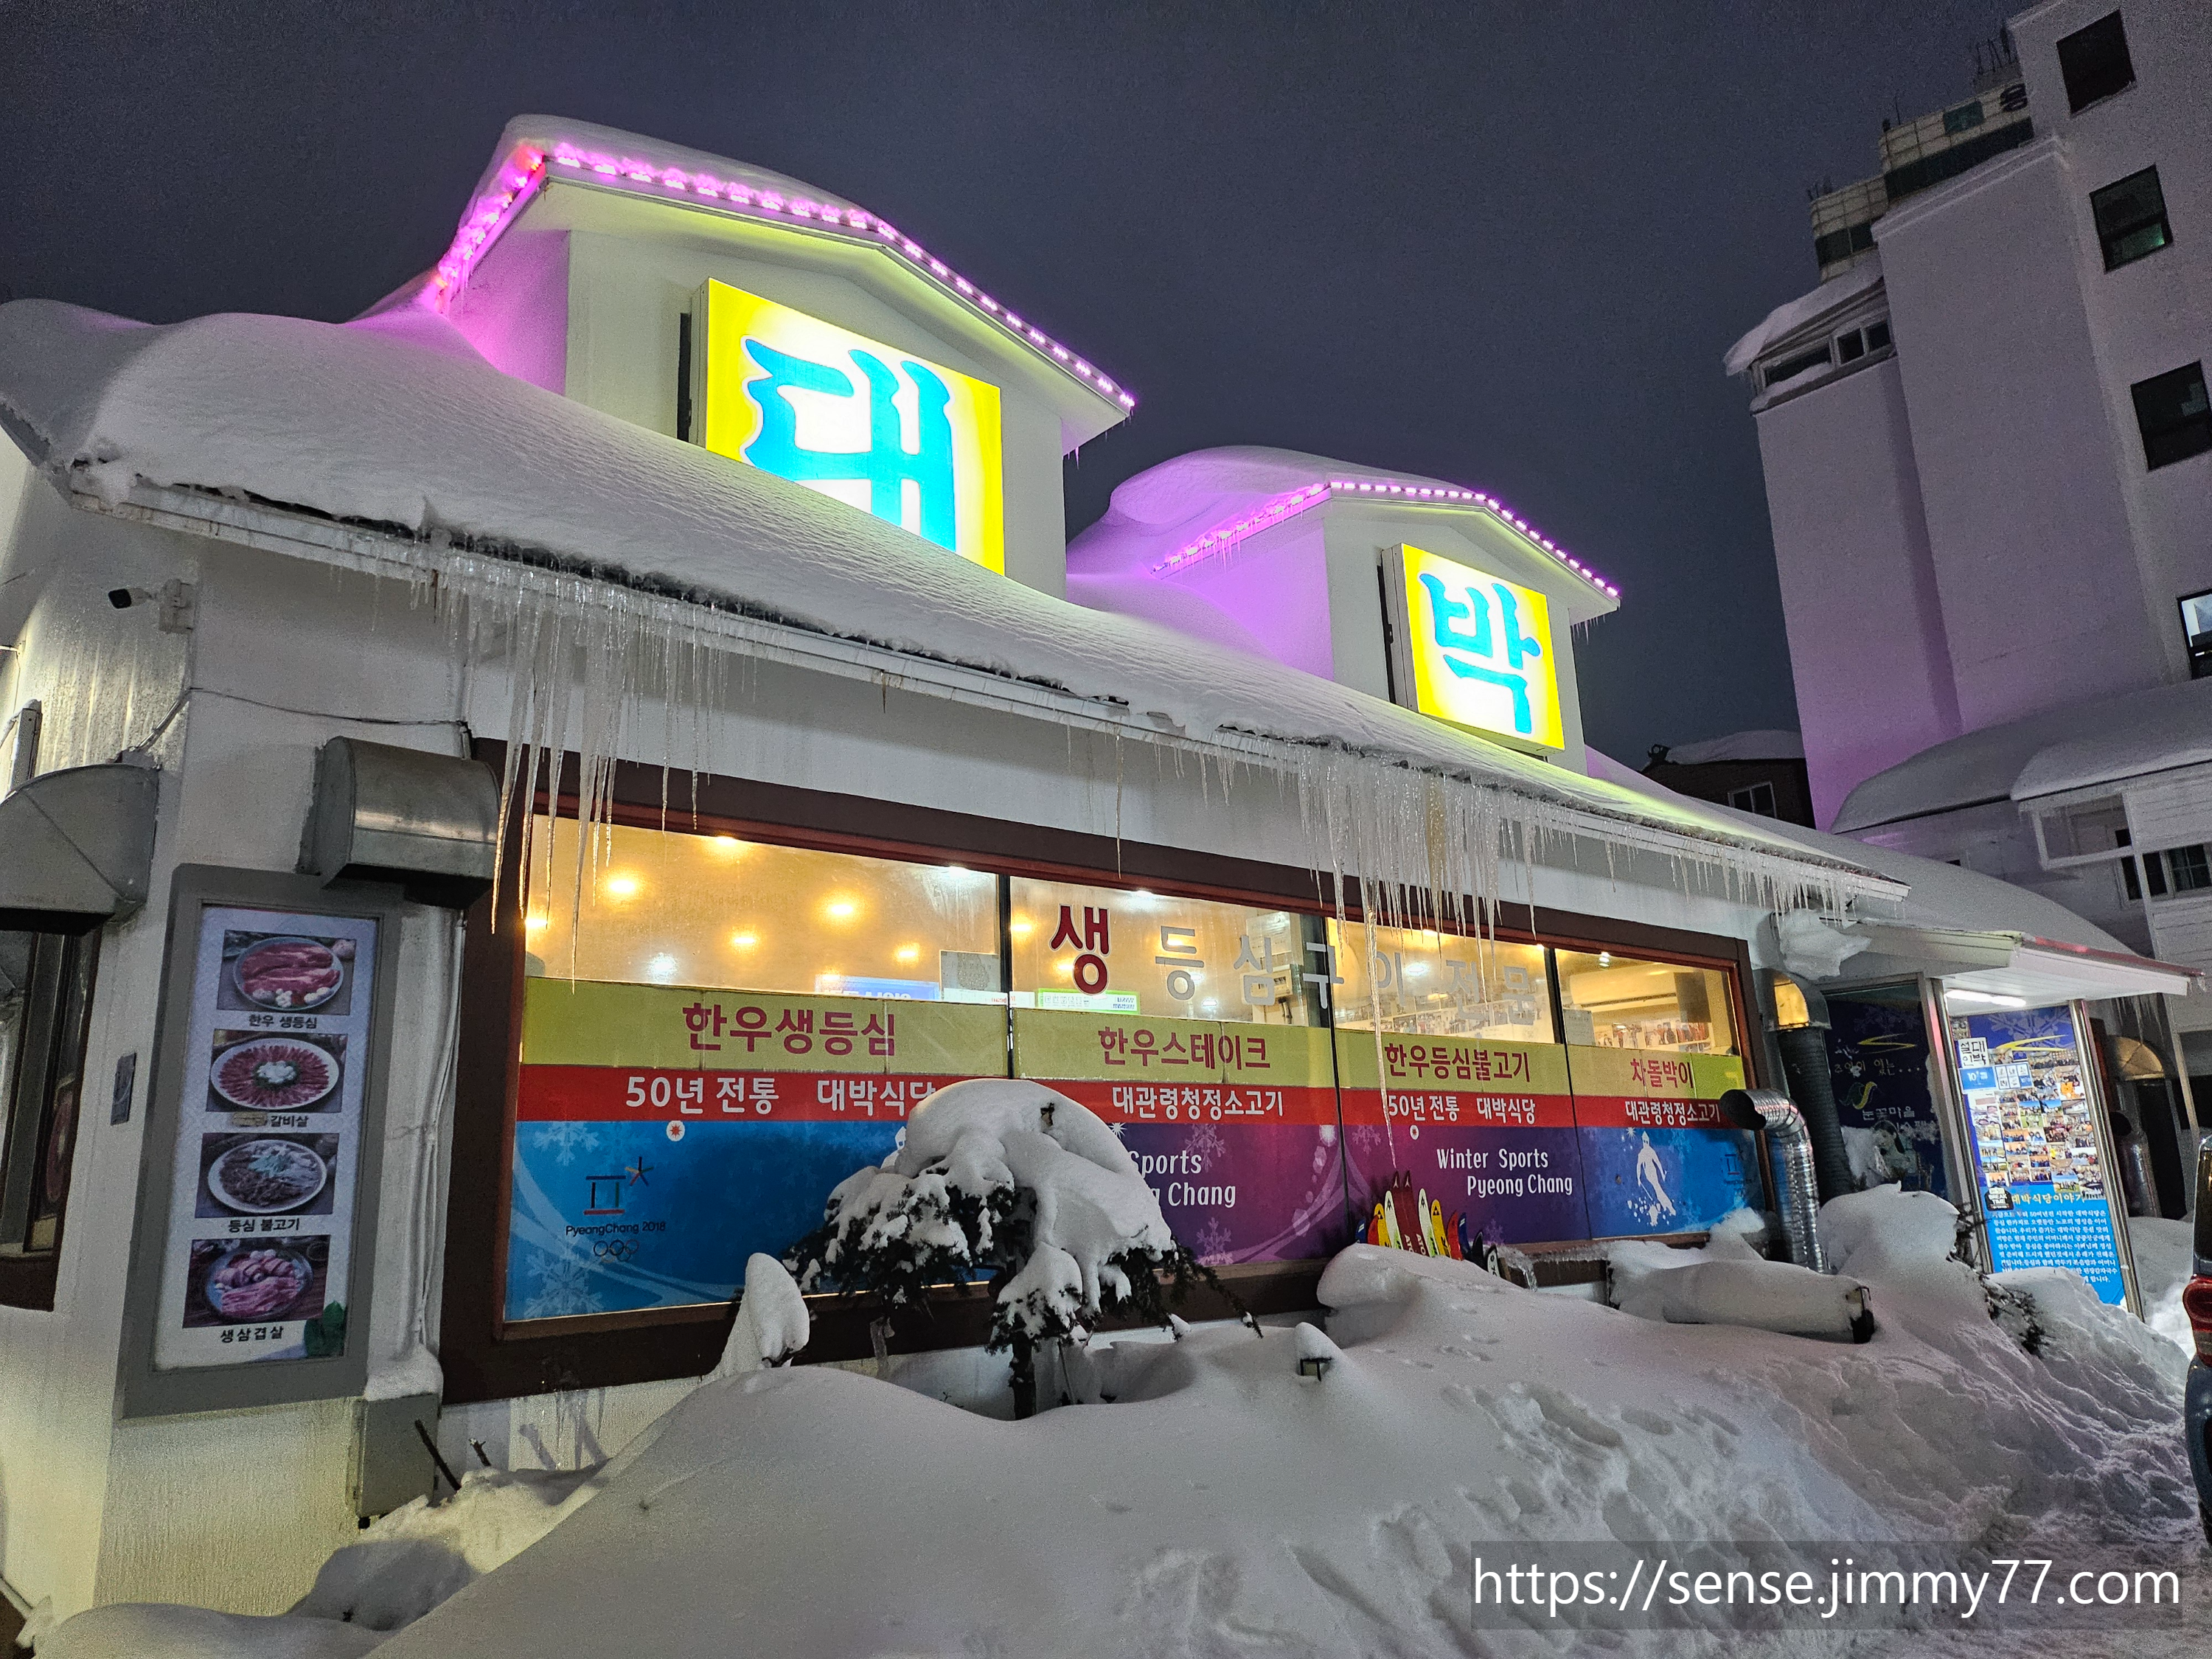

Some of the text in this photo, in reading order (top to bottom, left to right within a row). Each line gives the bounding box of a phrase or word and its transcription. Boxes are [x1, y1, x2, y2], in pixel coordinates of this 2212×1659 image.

[745, 338, 956, 552] 대
[1419, 574, 1540, 734] 박
[1051, 903, 1110, 995] 생
[248, 1015, 317, 1029] 한우 생등심
[682, 1002, 896, 1057] 한우생등심
[1098, 1026, 1270, 1071] 한우스테이크
[1384, 1043, 1531, 1082] 한우등심불고기
[1630, 1058, 1694, 1088] 차돌박이
[625, 1076, 703, 1116] 50년
[715, 1077, 779, 1116] 전통
[1113, 1086, 1283, 1120] 대관령청정소고기
[1388, 1095, 1536, 1124] 50년 전통 대박식당
[270, 1115, 309, 1127] 갈비살
[1624, 1100, 1720, 1126] 대관령청정소고기
[1436, 1147, 1548, 1171] Winter Sports
[1168, 1182, 1236, 1208] Chang
[1467, 1174, 1573, 1198] Pyeong Chang
[228, 1218, 299, 1233] 등심 불고기
[566, 1221, 666, 1237] PyeongChang 2018
[220, 1326, 284, 1343] 생삼겹살
